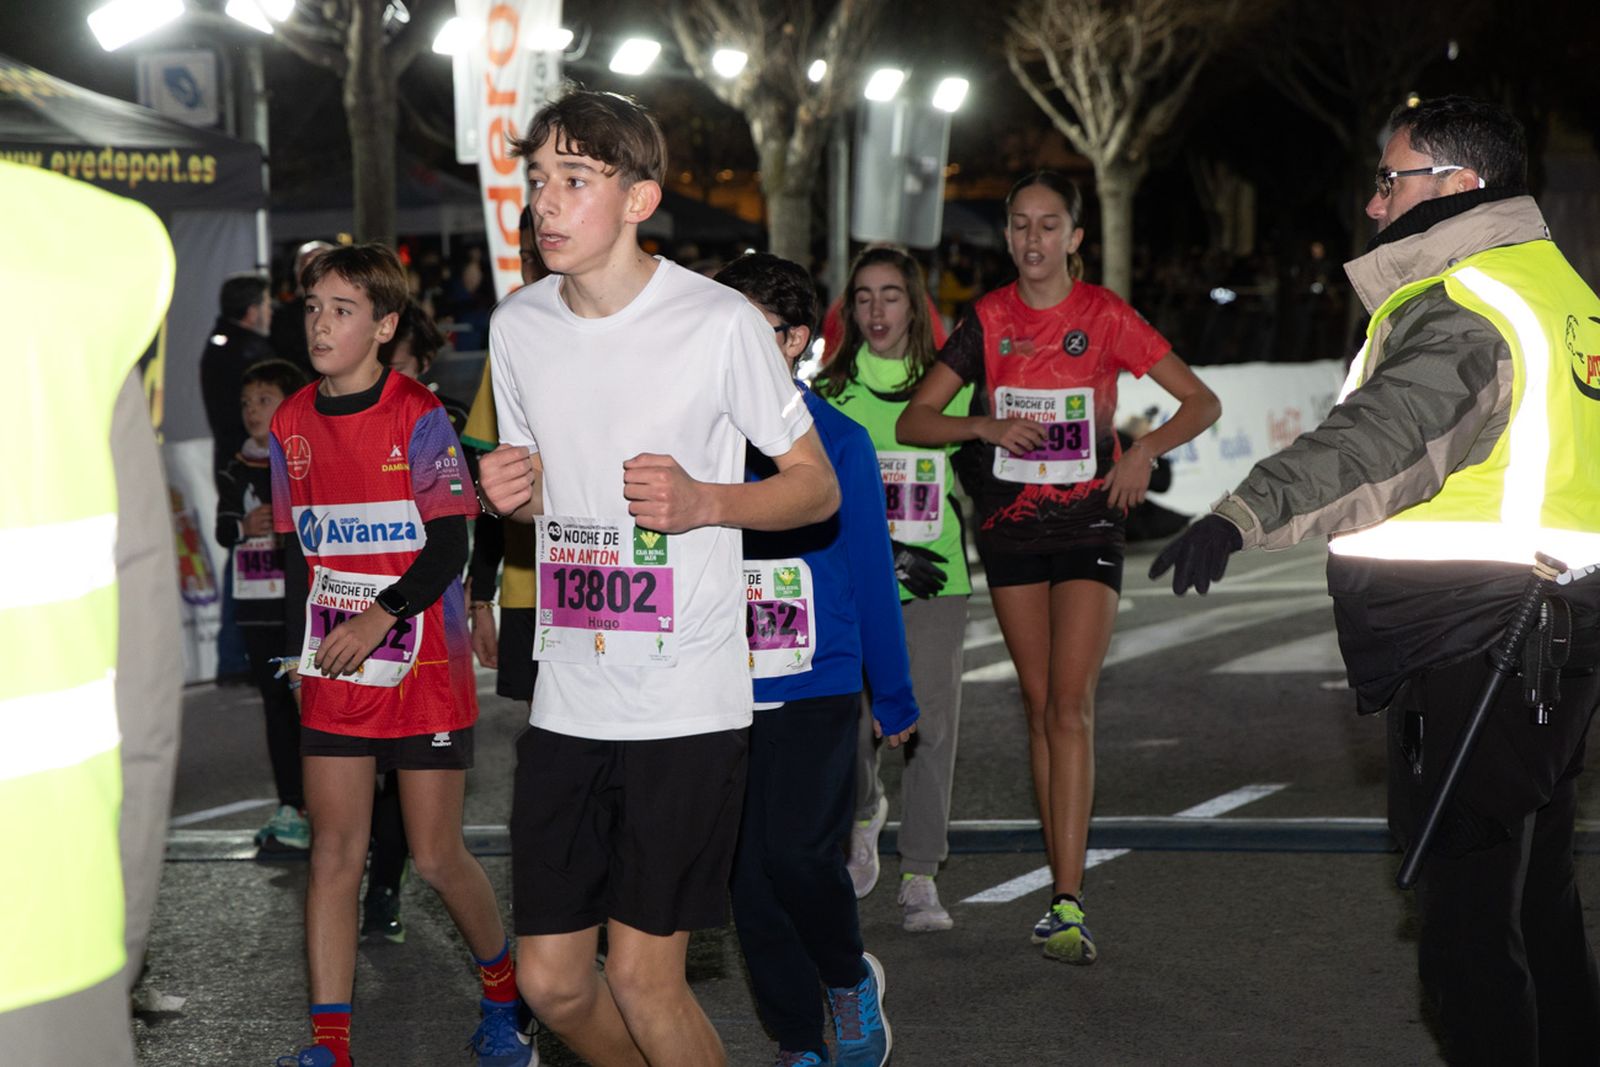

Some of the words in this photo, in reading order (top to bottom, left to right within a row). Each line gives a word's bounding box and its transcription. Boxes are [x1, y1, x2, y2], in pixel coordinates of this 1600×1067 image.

[1015, 399, 1042, 409] NOCHE
[1045, 400, 1056, 409] DE
[1037, 422, 1082, 451] 93
[326, 518, 417, 544] Avanza
[548, 525, 561, 536] 43
[564, 529, 600, 545] NOCHE
[603, 531, 619, 546] DE
[549, 547, 575, 563] SAN
[577, 546, 619, 565] ANTÓN
[748, 574, 762, 585] DE
[328, 583, 361, 597] NOCHE
[363, 587, 377, 598] DE
[553, 568, 657, 613] 13802
[746, 586, 762, 600] ÓN
[316, 594, 337, 607] SAN
[588, 616, 620, 630] Hugo
